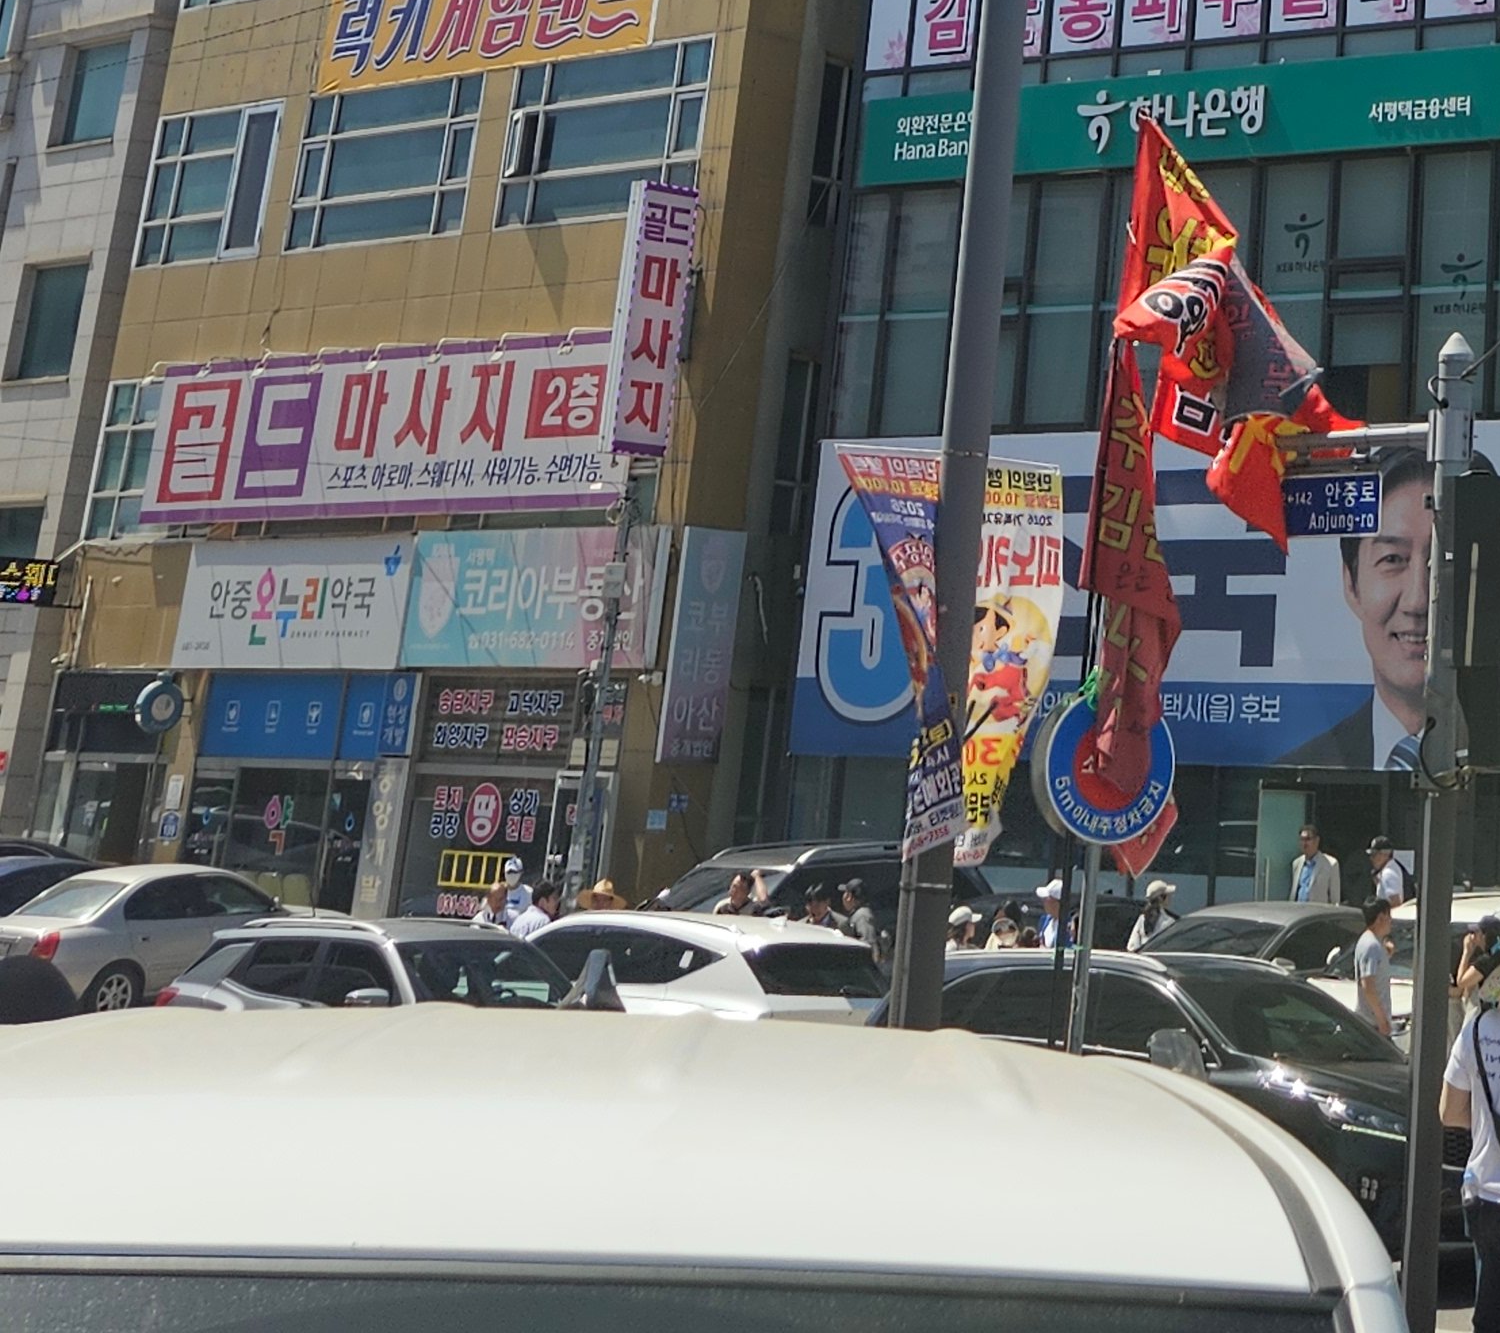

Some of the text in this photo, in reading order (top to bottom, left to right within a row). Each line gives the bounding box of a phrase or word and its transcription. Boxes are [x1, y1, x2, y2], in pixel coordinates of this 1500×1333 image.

[1129, 83, 1266, 140] 하나은행
[1366, 95, 1472, 124] 서평택금융센터
[894, 138, 970, 161] Hana Ban
[622, 199, 692, 434] 골드 마사지
[157, 360, 602, 503] 골드 마사지 2층
[1325, 480, 1377, 508] 안중로
[1308, 511, 1375, 532] Anjung-ro
[208, 566, 376, 647] 안중온누리약국
[506, 690, 564, 717] 고덕지구
[1160, 693, 1281, 724] 택시(을) 후보
[262, 794, 295, 857] 약
[433, 784, 465, 812] 토지
[470, 793, 499, 839] 땅
[509, 787, 540, 816] 상가
[430, 812, 461, 839] 공장
[505, 815, 537, 843] 건물
